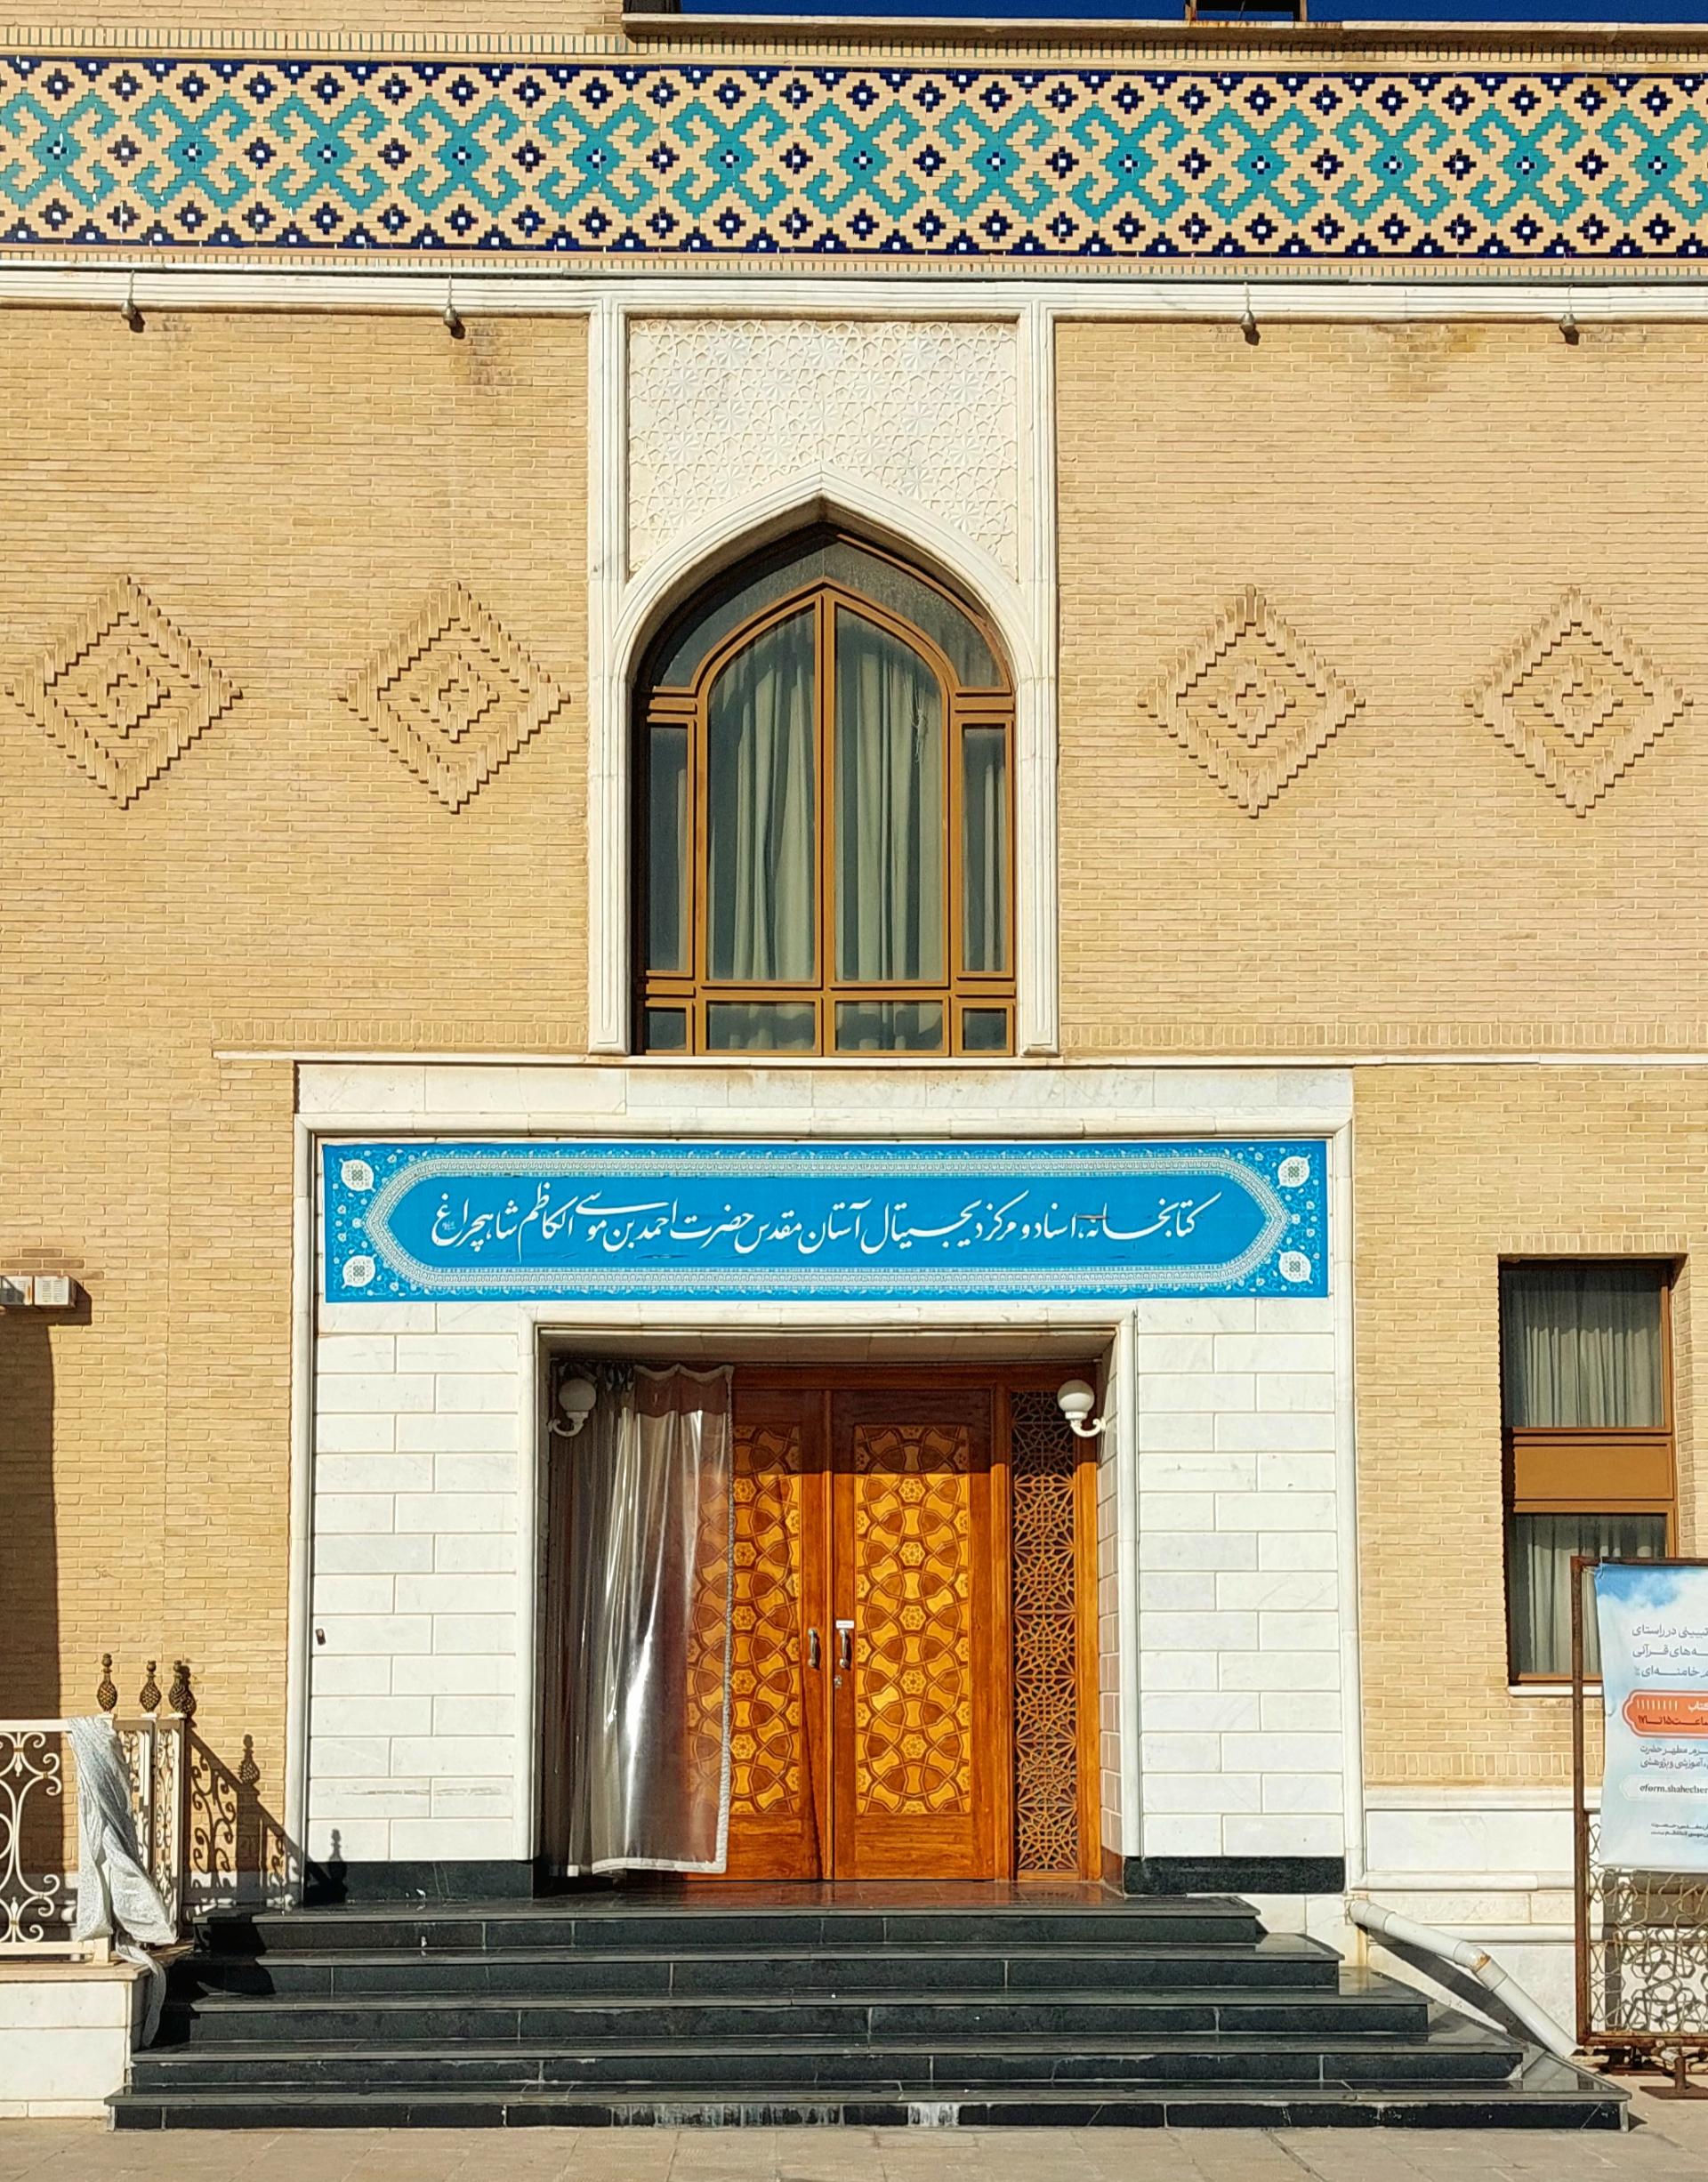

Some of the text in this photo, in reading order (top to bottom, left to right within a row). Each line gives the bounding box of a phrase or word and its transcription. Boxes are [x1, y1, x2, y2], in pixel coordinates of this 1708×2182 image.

[431, 1192, 519, 1253] شاهچراغ
[518, 1181, 579, 1264] الکاظم
[602, 1217, 635, 1253] بن
[637, 1199, 679, 1241] احمد
[671, 1204, 755, 1248] حضرت
[733, 1210, 803, 1255] مقدس
[798, 1200, 871, 1255] آستان
[860, 1199, 985, 1255] دیجیتال
[985, 1190, 1029, 1242] مرکز
[1020, 1223, 1031, 1240] و
[1034, 1202, 1077, 1240] اسناد
[1631, 1624, 1665, 1639] راستای
[1633, 1644, 1669, 1657] قرآنی
[1664, 1627, 1677, 1639] در
